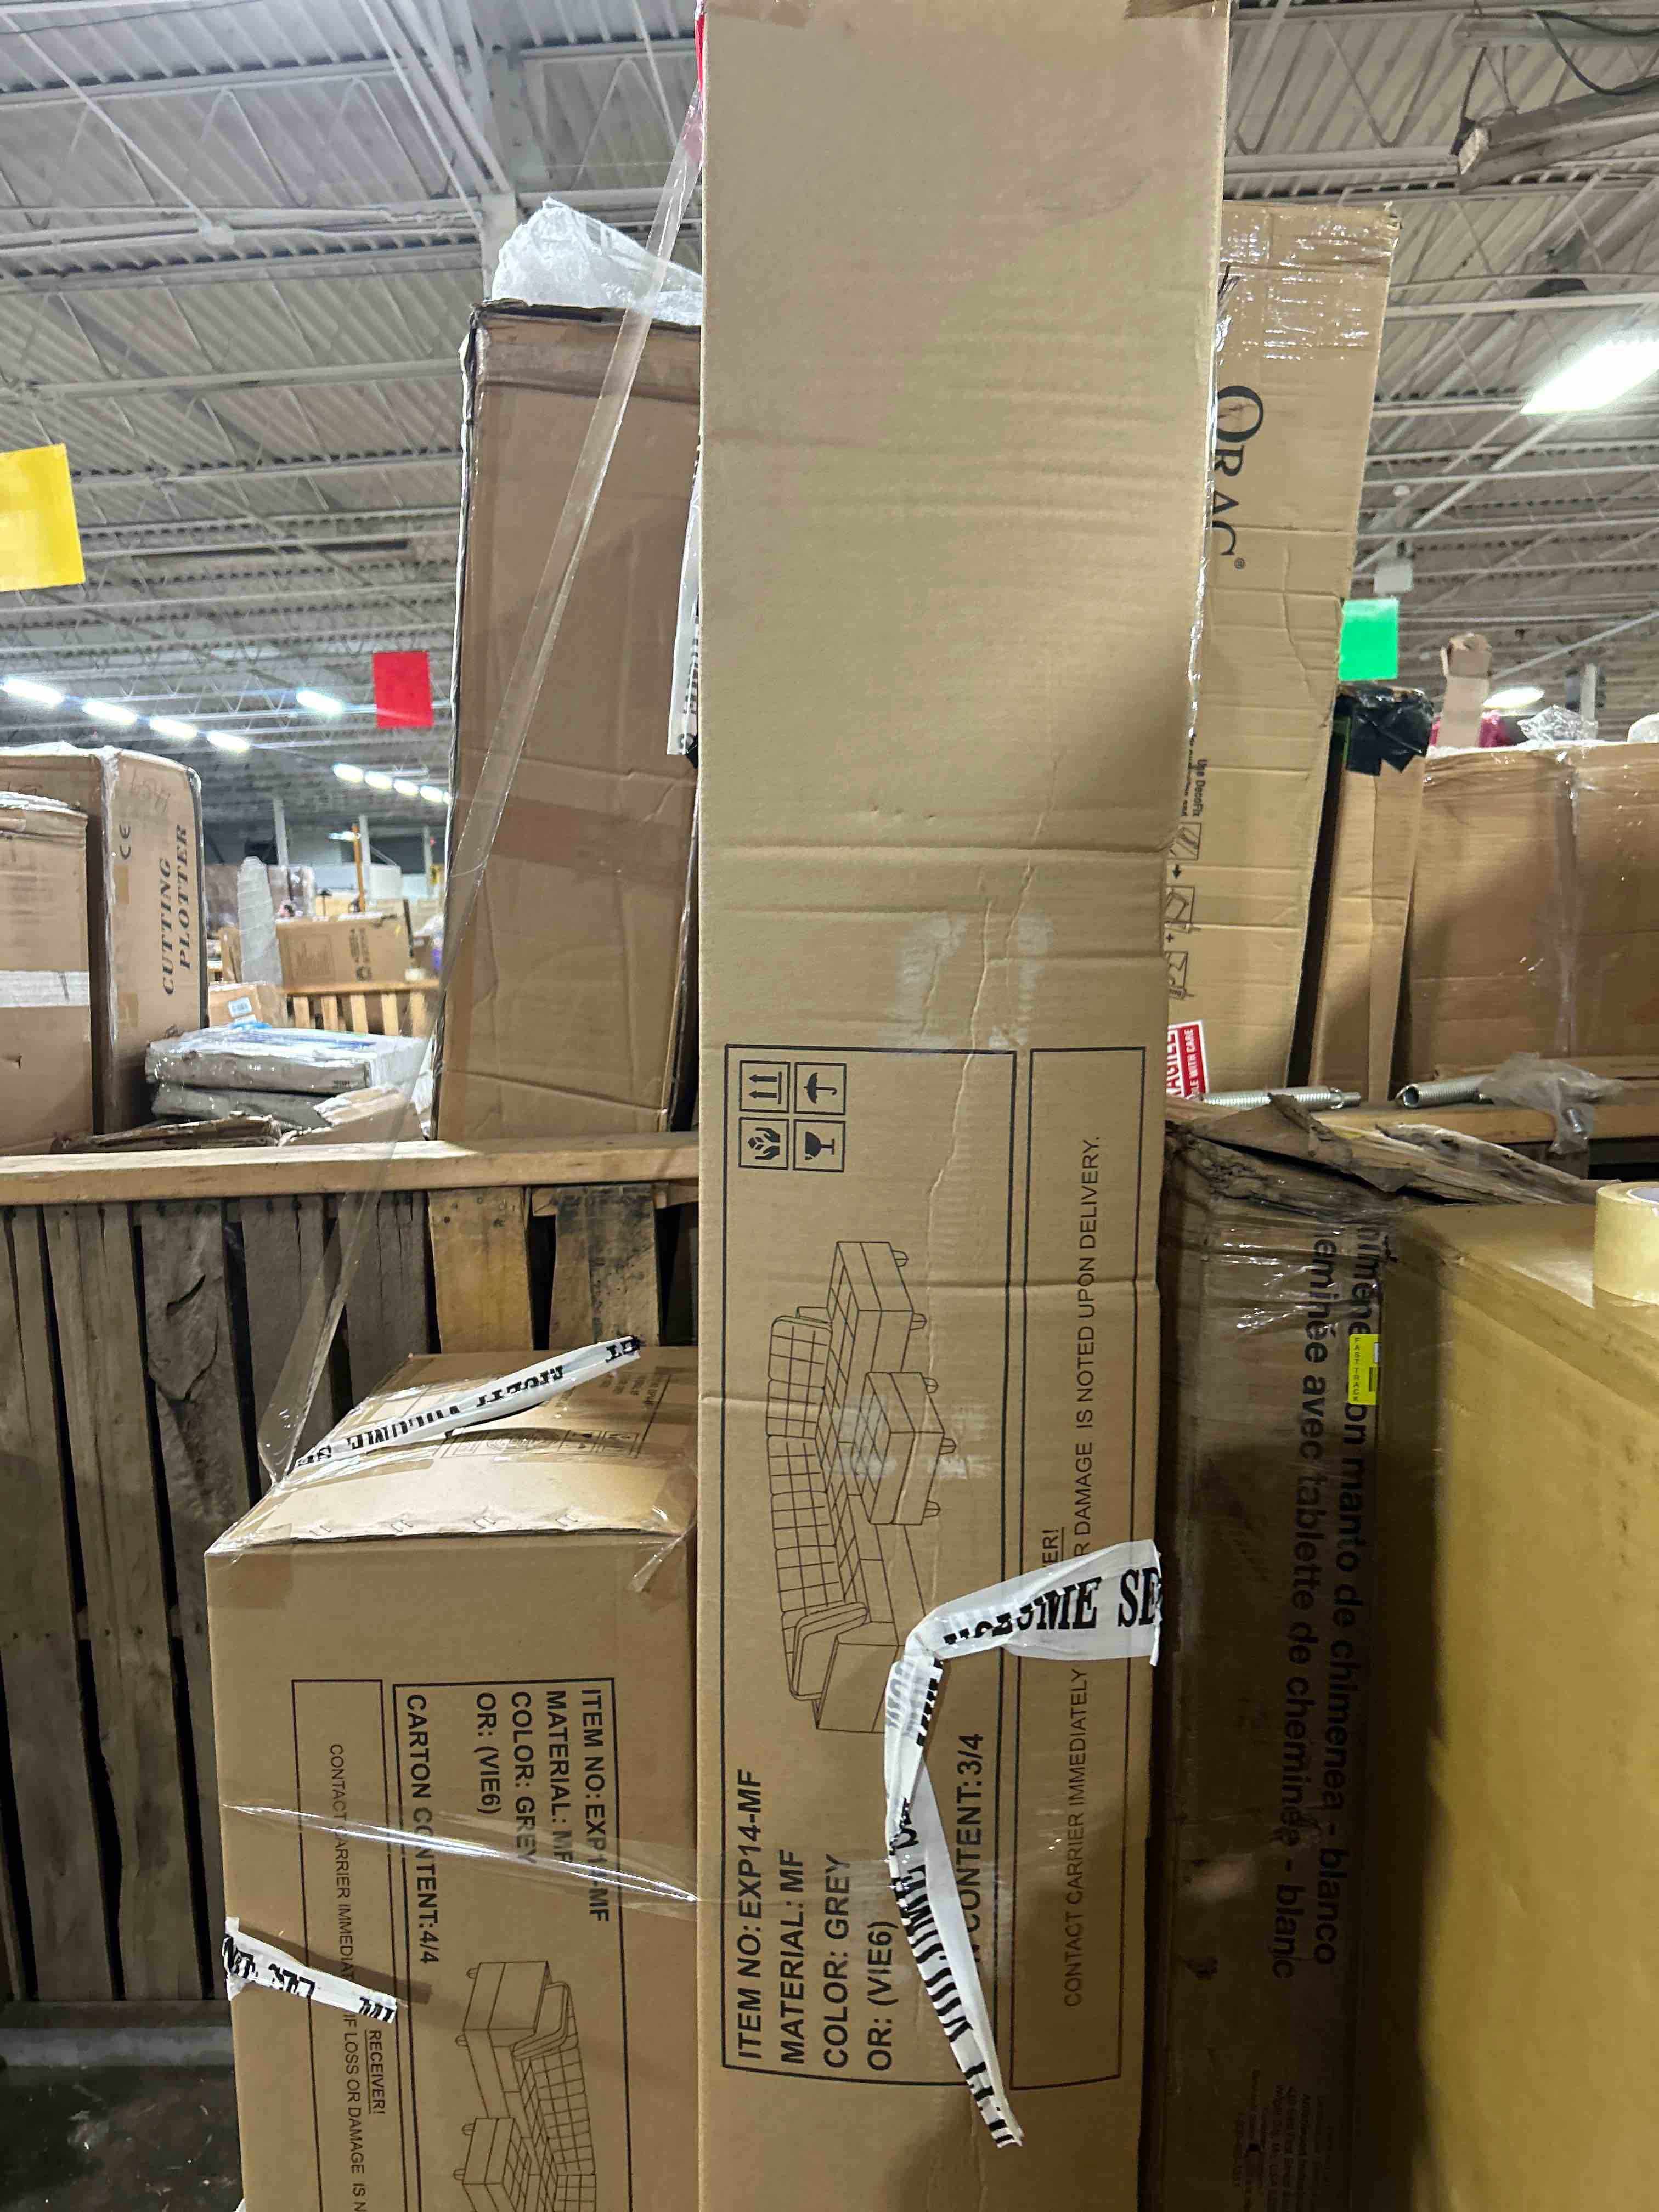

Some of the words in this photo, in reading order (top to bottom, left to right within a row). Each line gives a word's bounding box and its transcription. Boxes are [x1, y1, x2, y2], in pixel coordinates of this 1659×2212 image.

[159, 857, 174, 995] CUTTING
[176, 824, 190, 970] PLOTTER
[1167, 1029, 1181, 1096] AGILE
[1184, 1028, 1197, 1053] CARE
[1187, 1053, 1198, 1080] WITH
[1079, 1136, 1100, 1249] DELIVERY.
[1077, 1257, 1096, 1318] UPON
[1304, 1239, 1339, 1363] eminée
[1076, 1325, 1095, 1402] NOTED
[1076, 1409, 1093, 1429] IS
[1300, 1374, 1326, 1460] avec
[1344, 1402, 1368, 1444] on
[1074, 1441, 1093, 1536] DAMAGE
[1335, 1457, 1367, 1572] manto
[1074, 1541, 1090, 1557] R
[1291, 1475, 1328, 1611] tablette
[1288, 1621, 1319, 1665] de
[1333, 1584, 1364, 1628] de
[407, 1694, 431, 1799] CARTON
[476, 1692, 497, 1736] OR:
[511, 1691, 535, 1787] COLOR:
[582, 1689, 603, 1747] ITEM
[1068, 1668, 1088, 1806] IMMEDIATELY
[1322, 1640, 1361, 1810] chimenea
[329, 1744, 347, 1821] CONTACT
[474, 1746, 502, 1814] (VIE6)
[546, 1690, 571, 1823] MATERIAL:
[515, 1796, 537, 1864] GREY
[552, 1830, 573, 1863] MF
[1065, 1812, 1085, 1906] CARRIER
[1329, 1822, 1336, 1836] -
[779, 1849, 804, 1892] MF
[824, 1853, 850, 1940] GREY
[1314, 1848, 1348, 1966] blanco
[337, 1904, 355, 1982] IMMEDIAT
[867, 1921, 899, 2006] (VIE6)
[1064, 1914, 1083, 2007] CONTACT
[1272, 1883, 1306, 1979] blanc
[343, 2014, 357, 2027] IF
[780, 1901, 805, 2064] MATERIAL:
[823, 1951, 849, 2068] COLOR:
[344, 2032, 359, 2075] LOSS
[738, 1987, 762, 2059] ITEM
[867, 2018, 892, 2072] OR:
[346, 2079, 361, 2102] OR
[368, 2030, 386, 2114] RECEIVER!
[347, 2107, 365, 2174] DAMAGE
[352, 2183, 366, 2197] IS
